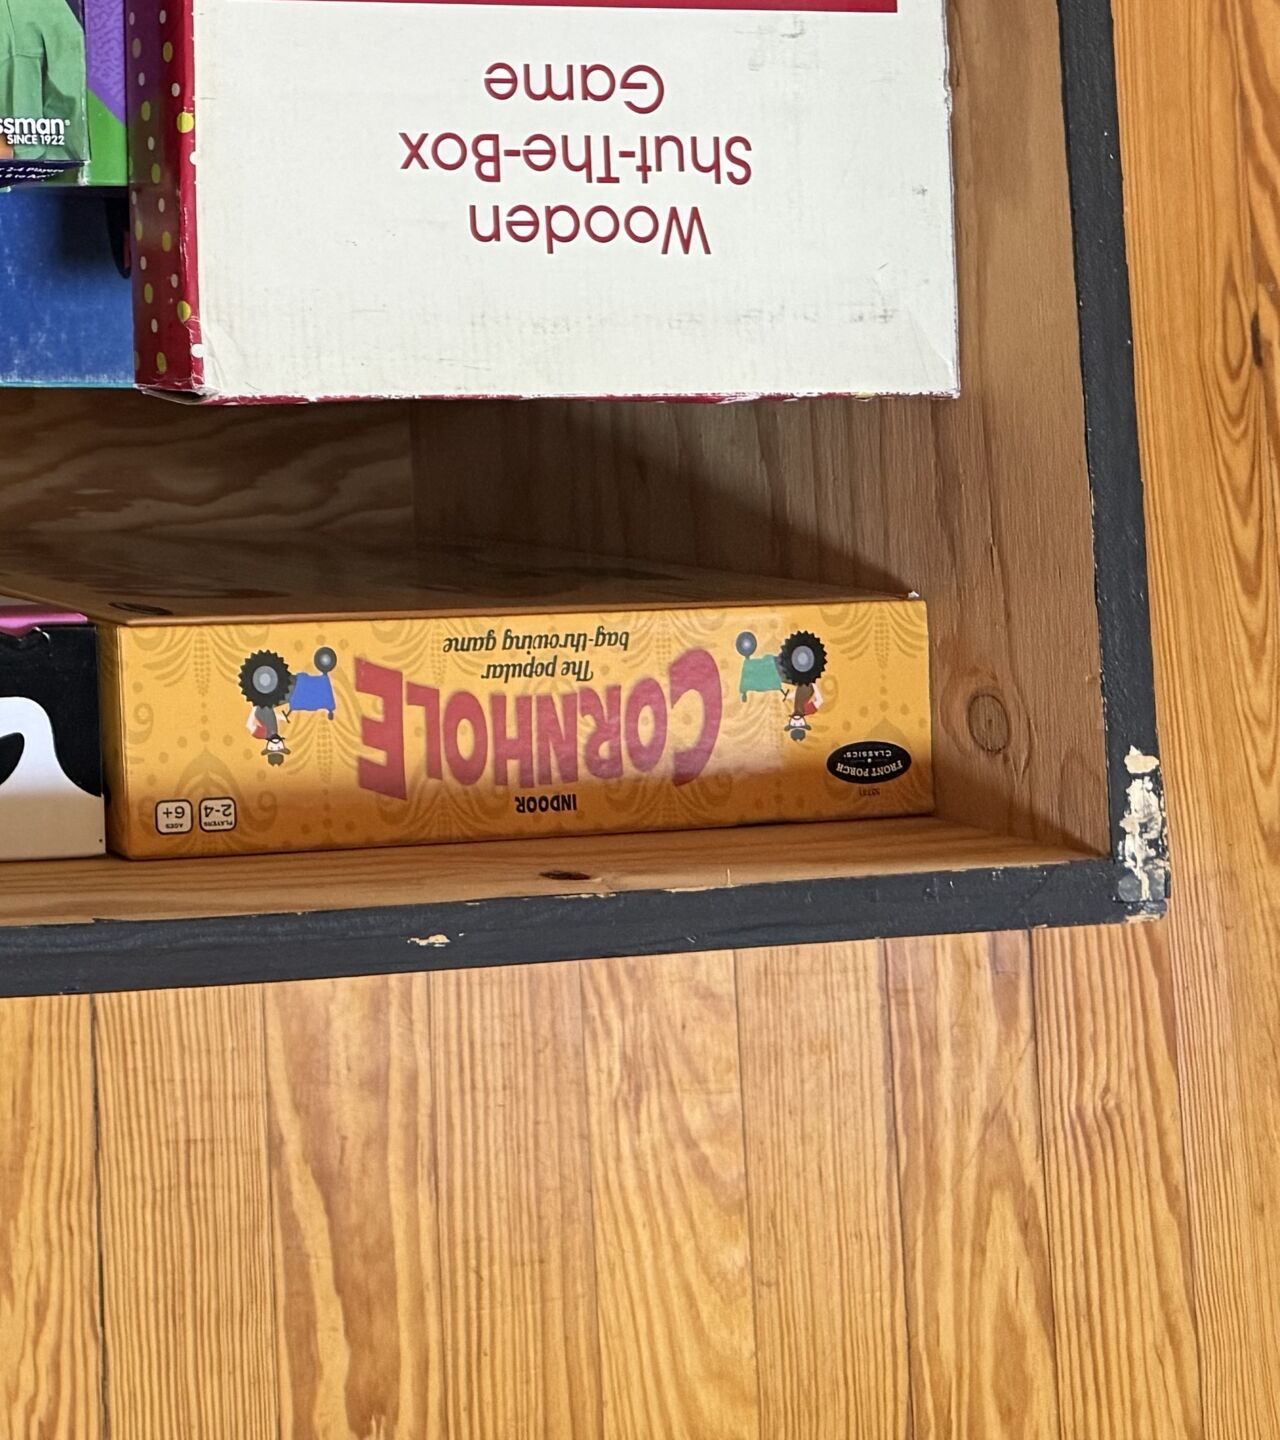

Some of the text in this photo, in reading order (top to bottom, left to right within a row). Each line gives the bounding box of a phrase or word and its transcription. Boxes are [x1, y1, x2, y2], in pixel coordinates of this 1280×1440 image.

[483, 62, 666, 114] Game
[7, 134, 64, 145] SINCE 1922
[398, 132, 753, 186] Shut-The-Box
[468, 203, 712, 255] Wooden
[442, 625, 630, 656] bag-throwing game
[480, 654, 595, 684] The popular
[355, 647, 723, 802] CORNHOLE
[846, 750, 892, 758] CLASSICS
[834, 759, 904, 778] FRONT PORCH
[163, 806, 185, 819] 6+
[204, 804, 232, 817] 2-4
[515, 792, 578, 814] INDOOR
